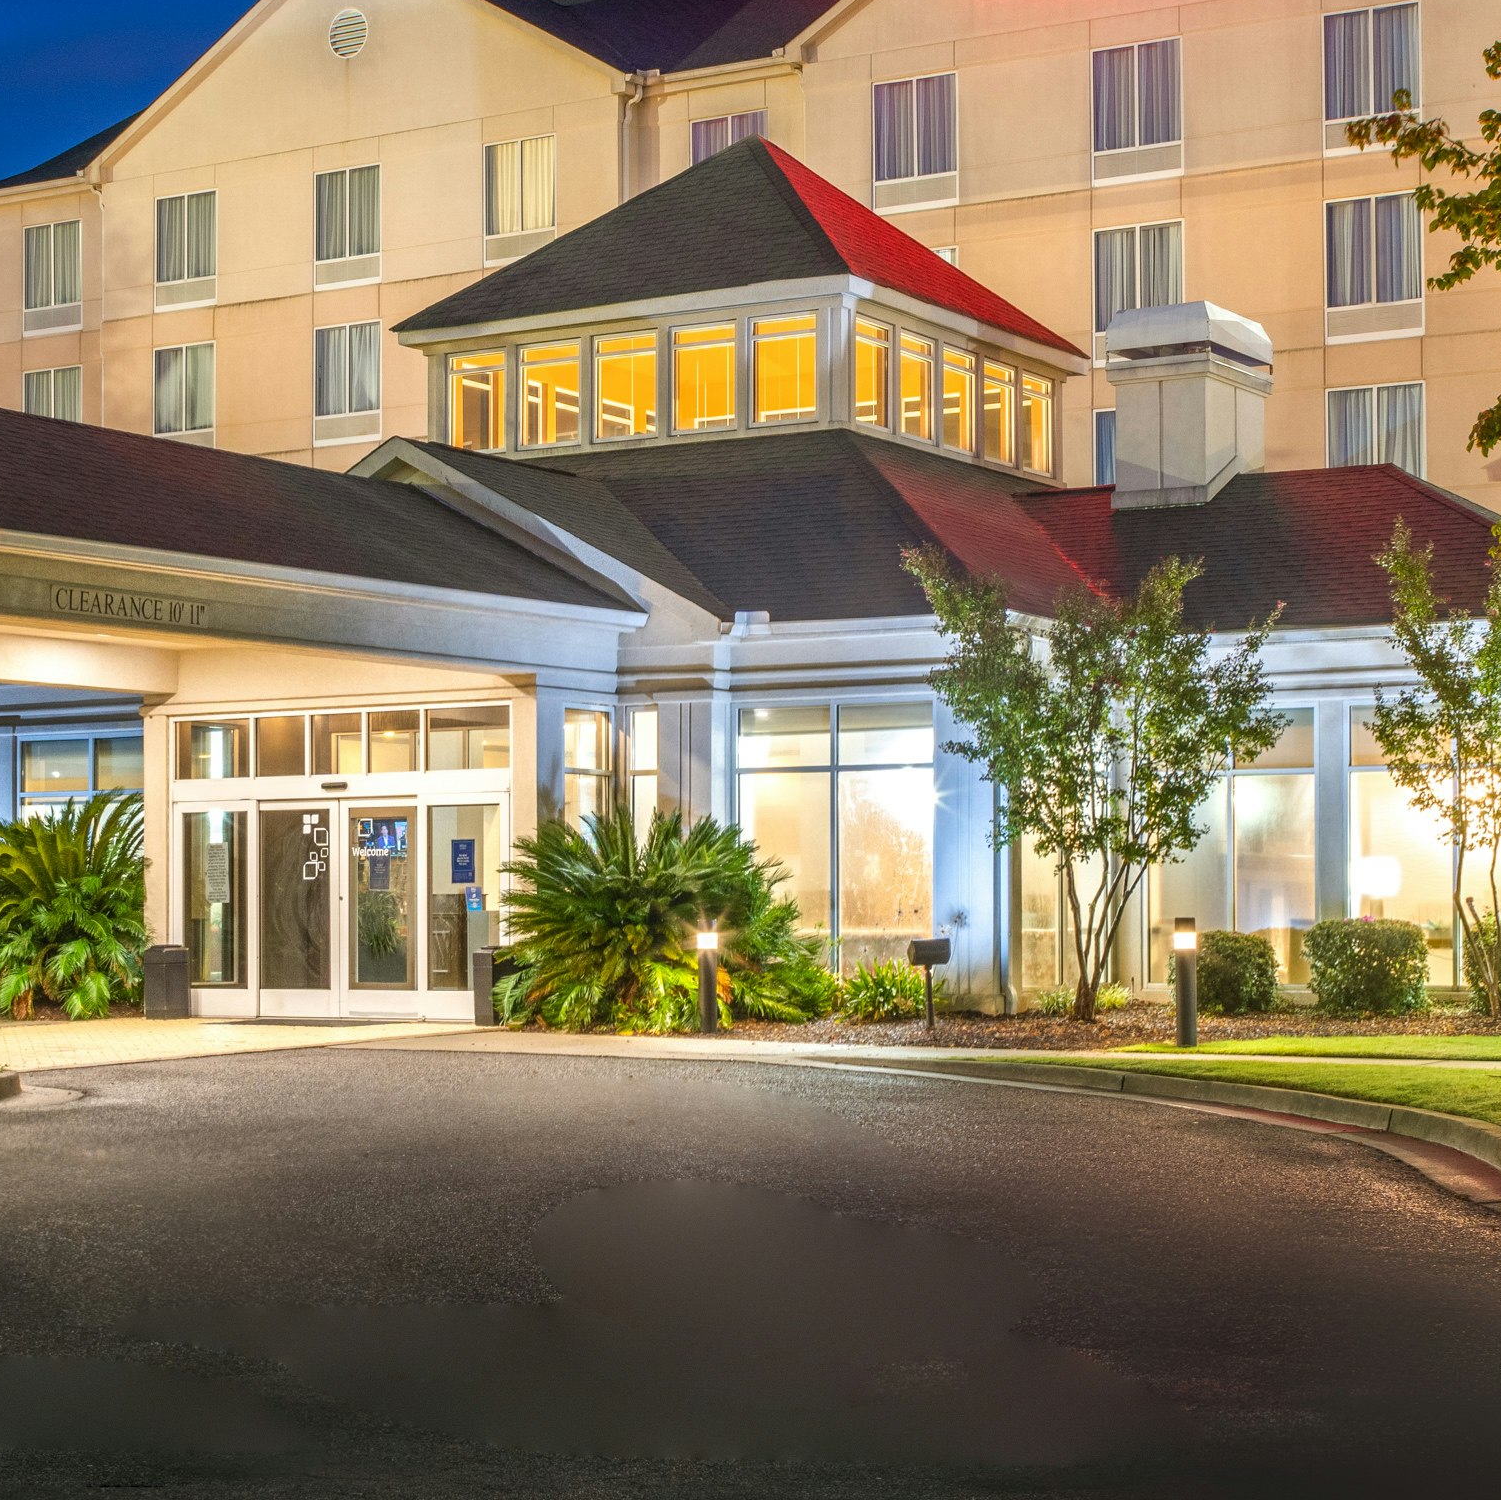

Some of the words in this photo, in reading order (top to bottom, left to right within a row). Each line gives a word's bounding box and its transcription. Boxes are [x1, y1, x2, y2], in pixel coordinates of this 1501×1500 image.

[55, 588, 164, 621] CLEARANCE
[168, 601, 185, 624] 10'
[352, 846, 389, 857] Welcome
